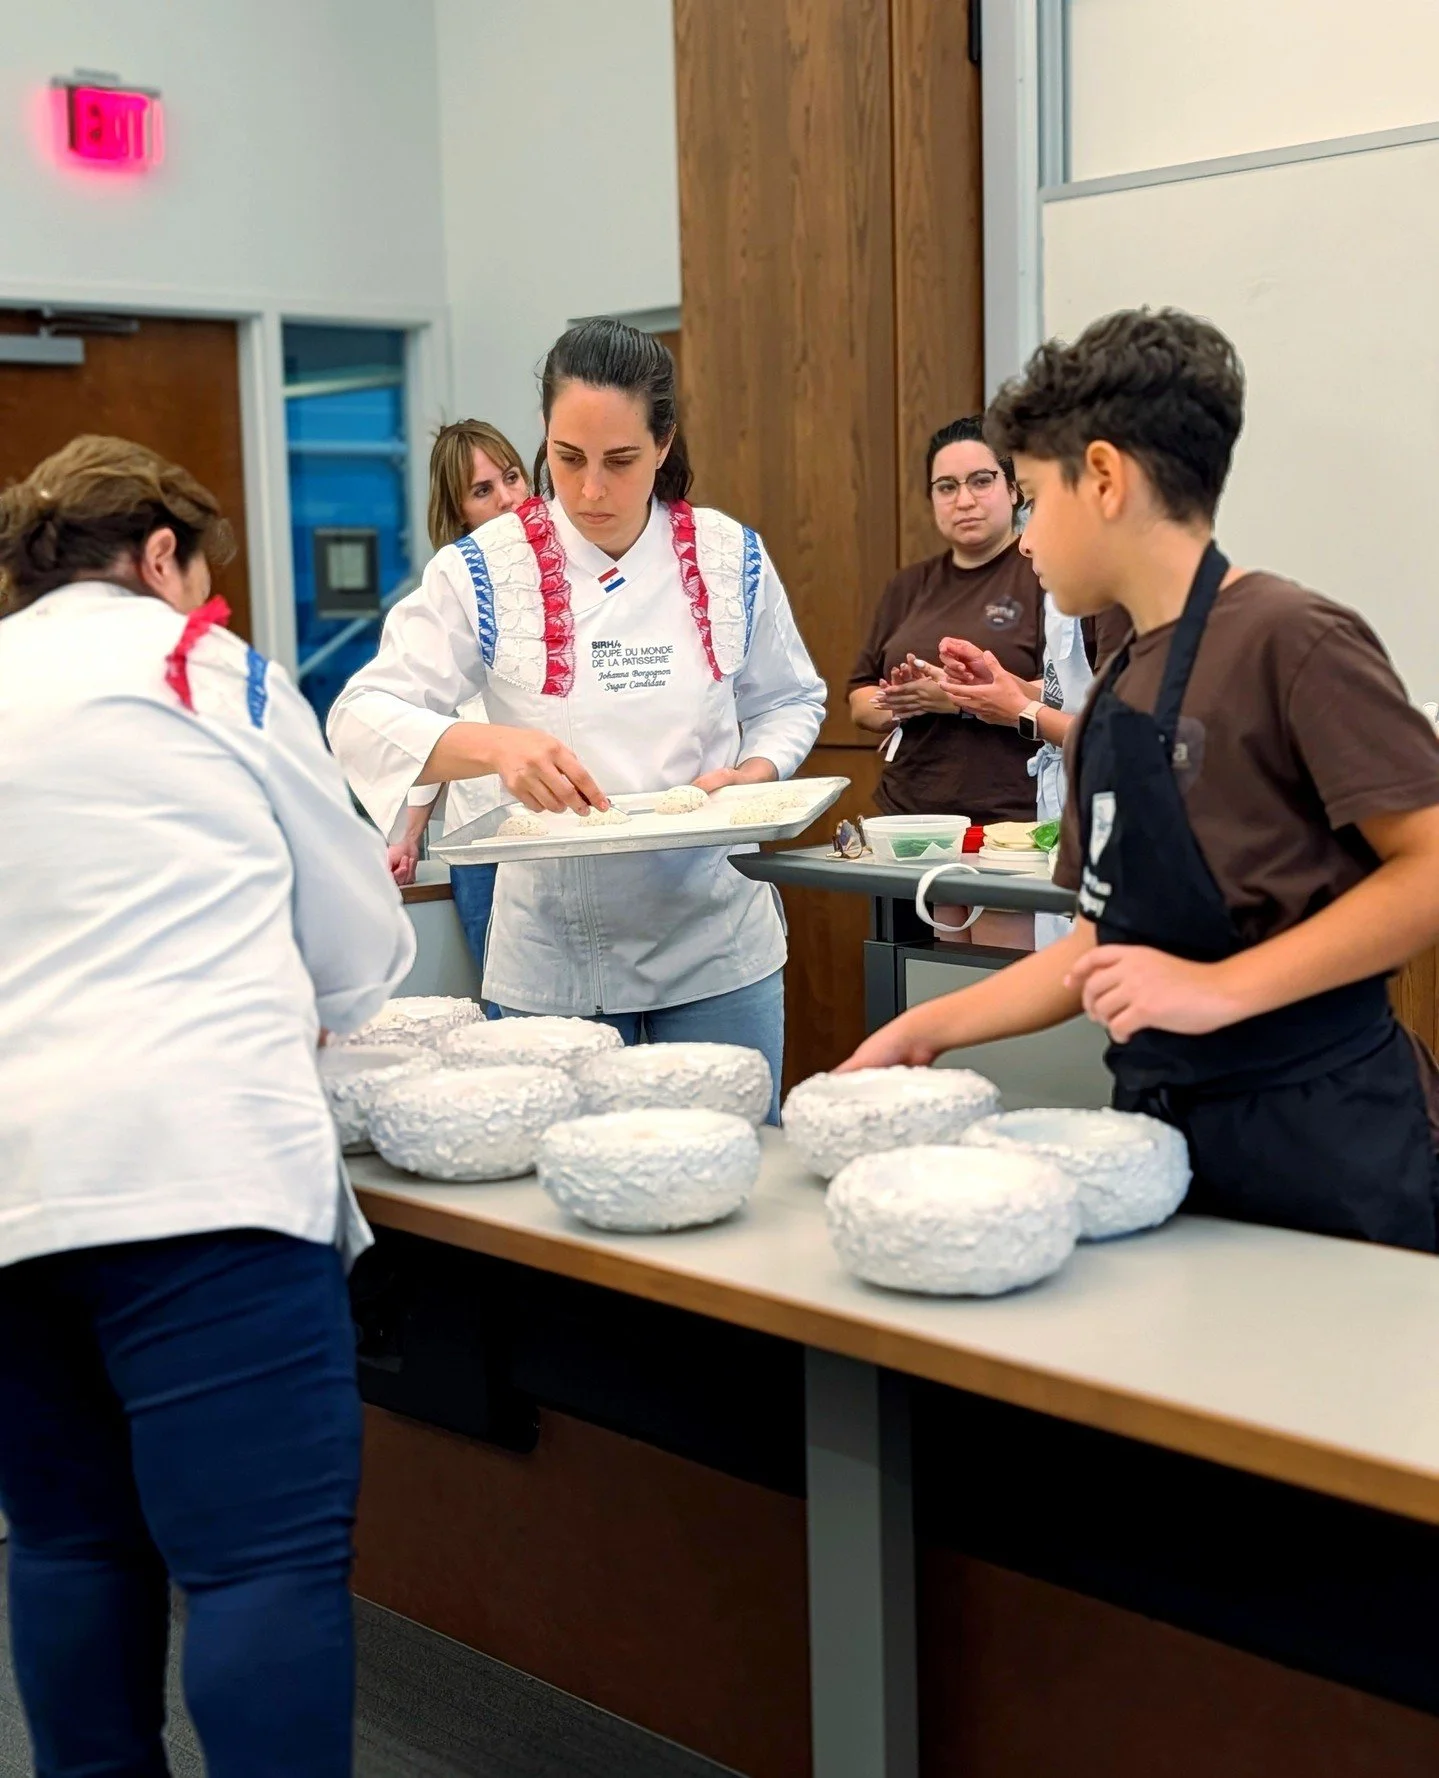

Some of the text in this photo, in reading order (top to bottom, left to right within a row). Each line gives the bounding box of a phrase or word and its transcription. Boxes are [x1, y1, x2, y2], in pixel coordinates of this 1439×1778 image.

[592, 645, 673, 658] COUPE DU MONDE
[592, 655, 669, 668] DE LA PATISSERIE
[598, 671, 629, 681] Johanna
[604, 678, 666, 692] Sugar Candidate
